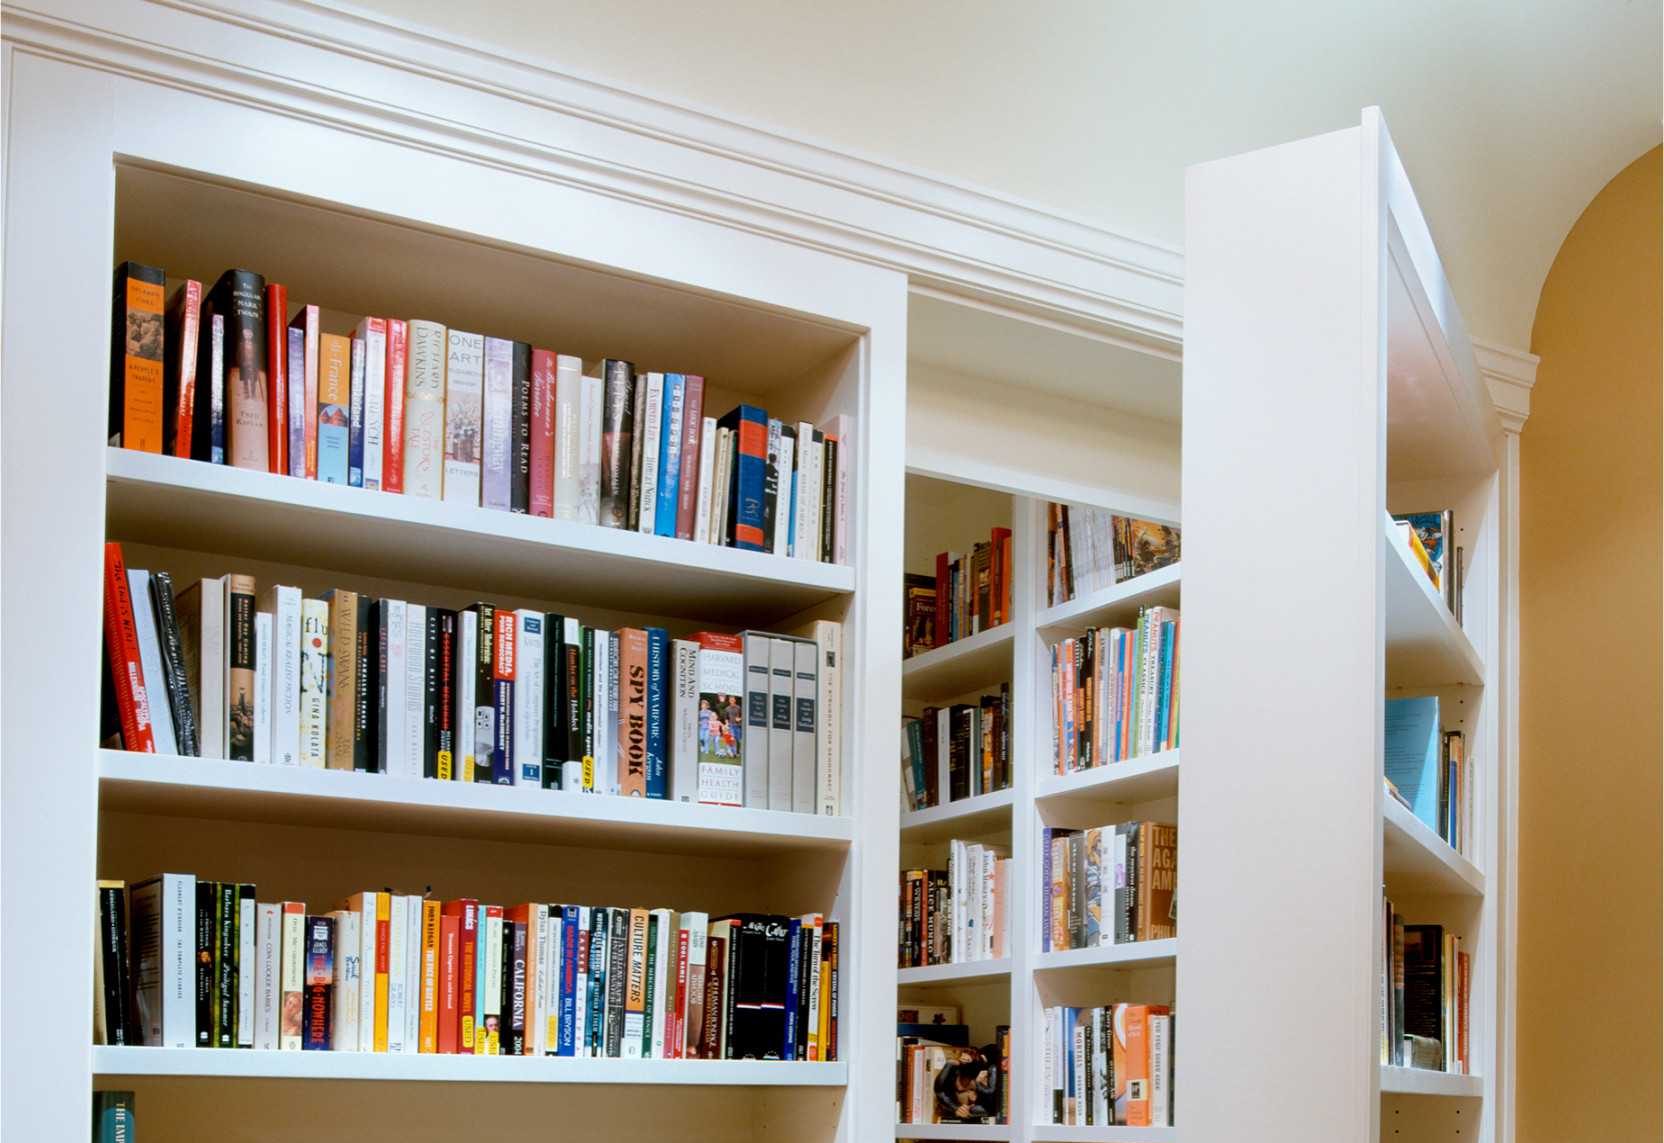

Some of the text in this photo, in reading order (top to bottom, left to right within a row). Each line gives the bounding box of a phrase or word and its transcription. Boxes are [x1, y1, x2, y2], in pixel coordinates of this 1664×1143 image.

[237, 300, 257, 309] MARK
[237, 309, 259, 318] TWAIN
[414, 327, 429, 387] DAWKINS
[449, 352, 480, 365] ART
[450, 335, 482, 349] ONE
[430, 330, 442, 390] RICHARD
[328, 358, 342, 400] France
[520, 381, 530, 473] POEMS READ
[285, 615, 293, 646] MAGICAL
[505, 616, 513, 640] RICH
[338, 608, 351, 688] WILD SWANS
[1148, 611, 1160, 696] PEANUTS TREASURY
[128, 662, 139, 701] MILLENNIUM
[408, 622, 424, 711] HOLLYWOOD STUDIOS
[680, 648, 688, 698] COGNITION
[688, 649, 696, 698] MIND AND
[651, 642, 660, 738] HISTORY WARFARE
[136, 709, 145, 731] UTOPIA
[311, 698, 319, 757] GINA KOLATA
[571, 700, 579, 731] Holodeck
[629, 665, 644, 776] SPY BOOK
[701, 779, 739, 788] HEALTH
[702, 766, 739, 776] FAMILY
[701, 791, 738, 801] GUIDE
[222, 920, 231, 957] Kingsolver
[537, 911, 546, 932] Dylan
[927, 916, 935, 954] MUNRO
[565, 959, 573, 994] AMERICA
[630, 916, 644, 1002] CULTURE MATTERS
[221, 963, 231, 997] Prodigal
[513, 960, 524, 1026] CALIFORNIA
[222, 999, 231, 1027] Summer
[564, 998, 572, 1013] BILL
[514, 1036, 522, 1054] 2004
[115, 1103, 125, 1122] THE
